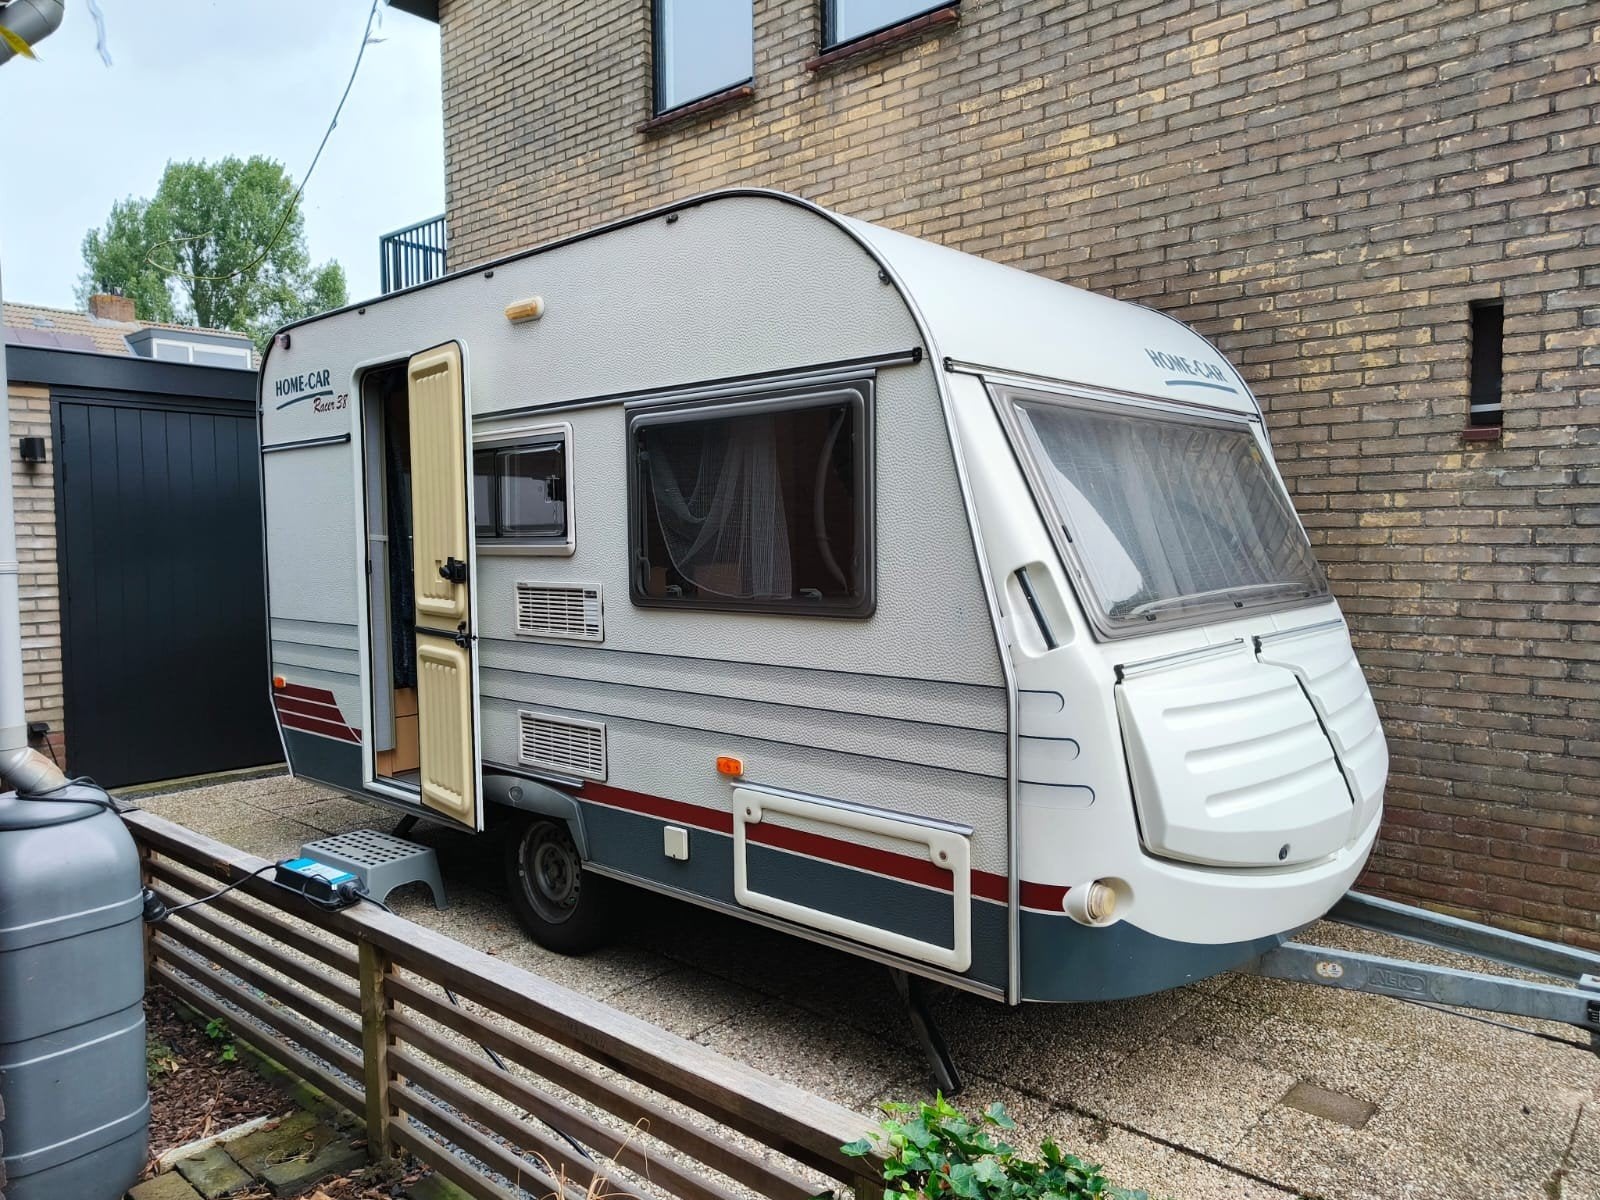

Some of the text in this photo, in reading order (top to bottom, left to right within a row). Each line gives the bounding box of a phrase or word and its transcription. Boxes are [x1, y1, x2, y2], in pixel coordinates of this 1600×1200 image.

[1144, 347, 1229, 383] HOME-CAR
[275, 369, 330, 397] HOME-CAR
[313, 394, 349, 414] Racer 38
